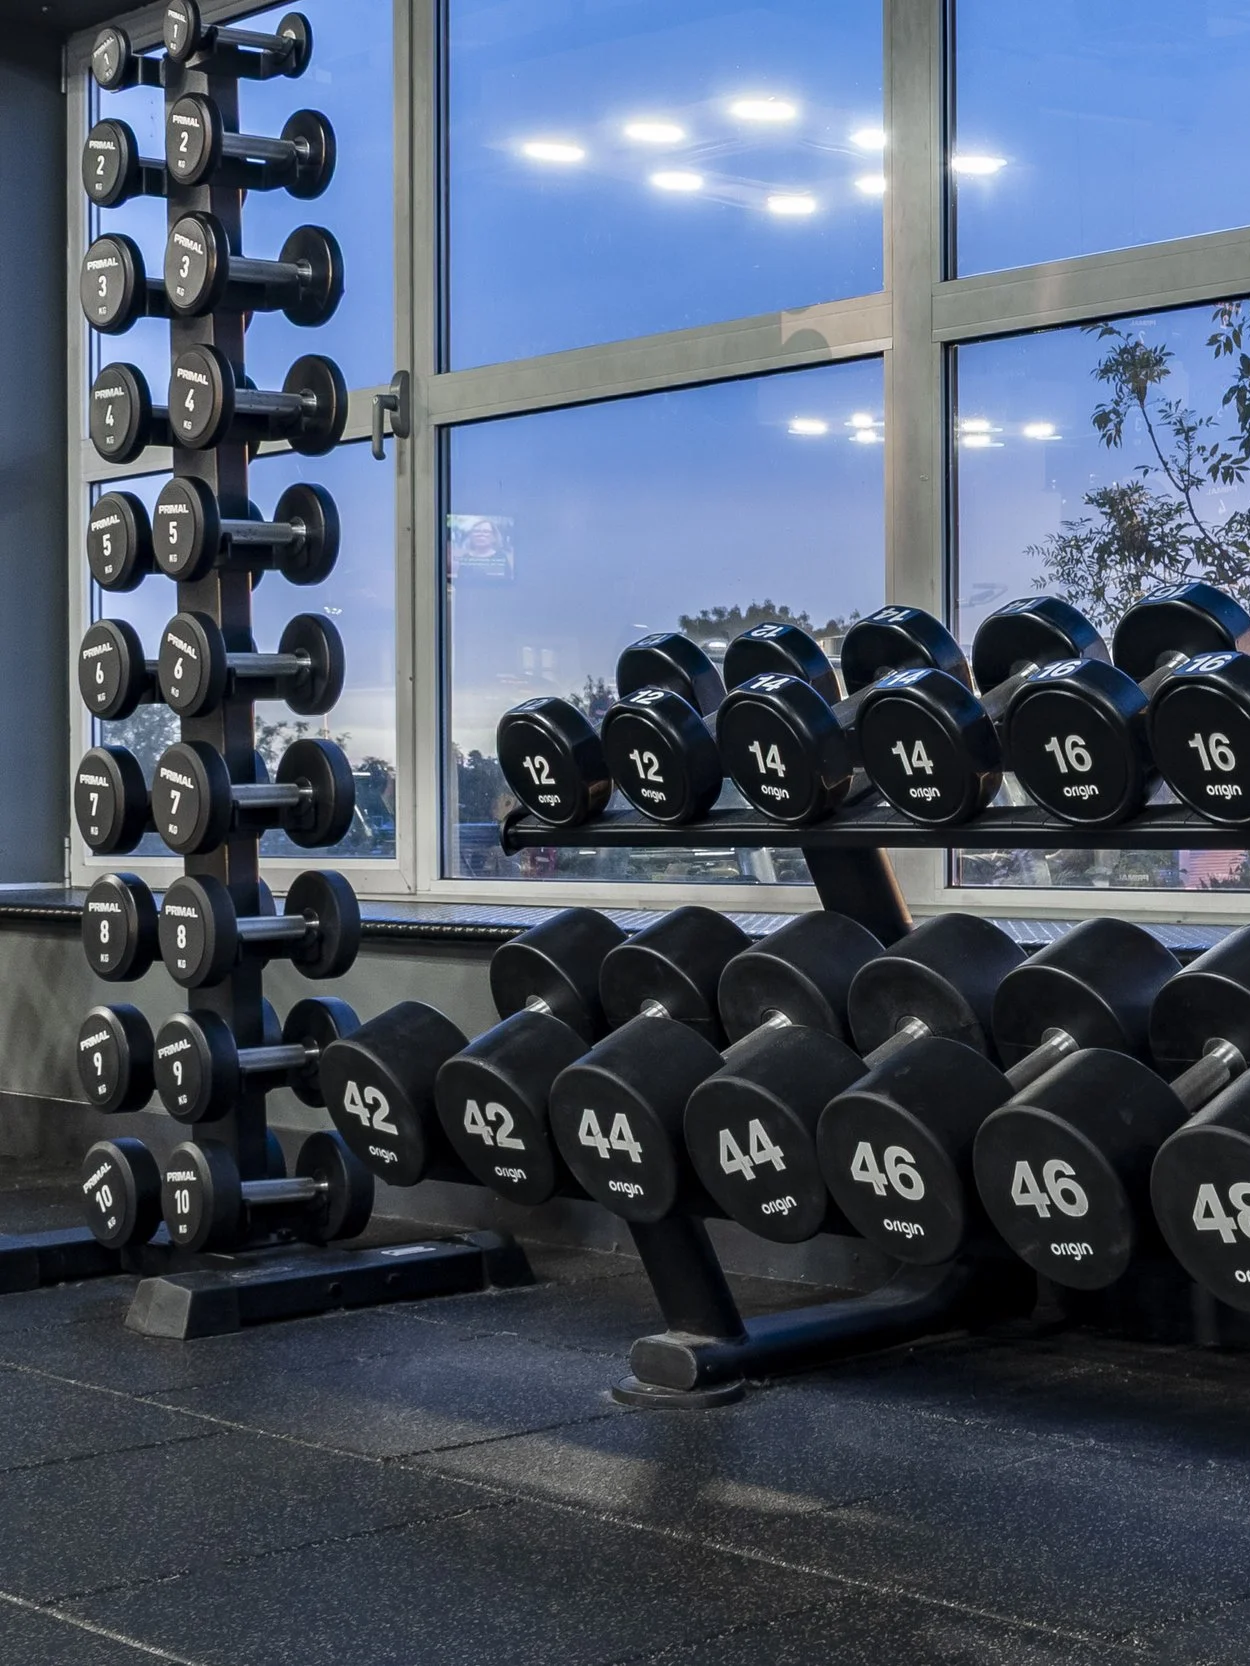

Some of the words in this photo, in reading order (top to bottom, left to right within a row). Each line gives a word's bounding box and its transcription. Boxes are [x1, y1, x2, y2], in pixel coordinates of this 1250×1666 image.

[174, 25, 177, 38] 1
[173, 115, 199, 127] PRIMAL
[89, 141, 115, 149] PRIMAL
[180, 132, 188, 152] 2
[97, 156, 104, 175] 2
[178, 160, 185, 168] KG
[174, 234, 203, 254] PRIMAL
[87, 258, 118, 270] PRIMAL
[180, 256, 189, 277] 3
[99, 276, 106, 296] 3
[177, 287, 184, 296] KG
[177, 368, 208, 385] PRIMAL
[95, 387, 124, 399] PRIMAL
[185, 389, 194, 411] 4
[106, 405, 114, 426] 4
[184, 421, 191, 429] KG
[107, 436, 114, 444] KG
[159, 504, 188, 513] PRIMAL
[91, 515, 120, 531] PRIMAL
[170, 522, 177, 544] 5
[103, 534, 111, 556] 5
[169, 554, 177, 562] KG
[105, 565, 112, 574] KG
[83, 643, 112, 659] PRIMAL
[168, 633, 197, 661] PRIMAL
[174, 658, 183, 679] 6
[1038, 662, 1080, 680] 16
[1189, 654, 1233, 672] 16
[96, 662, 104, 683] 6
[889, 670, 929, 686] 14
[752, 675, 790, 690] 14
[98, 693, 105, 701] KG
[171, 687, 179, 697] KG
[629, 689, 665, 705] 12
[749, 741, 785, 777] 14
[892, 741, 933, 775] 14
[1045, 735, 1092, 773] 16
[1189, 733, 1235, 771] 16
[523, 756, 555, 784] 12
[630, 750, 663, 782] 12
[80, 774, 108, 786] PRIMAL
[160, 768, 193, 788] PRIMAL
[538, 795, 560, 806] origin
[641, 789, 666, 802] origin
[761, 785, 789, 800] origin
[910, 787, 940, 801] origin
[1064, 785, 1098, 799] origin
[1207, 785, 1242, 799] origin
[90, 793, 98, 816] 7
[171, 790, 180, 814] 7
[91, 827, 98, 835] KG
[169, 824, 177, 834] KG
[89, 903, 121, 912] PRIMAL
[166, 905, 198, 917] PRIMAL
[101, 920, 109, 943] 8
[177, 925, 186, 948] 8
[101, 954, 109, 962] KG
[178, 960, 186, 968] KG
[80, 1031, 109, 1051] PRIMAL
[158, 1039, 191, 1058] PRIMAL
[94, 1052, 102, 1075] 9
[173, 1061, 182, 1085] 9
[98, 1084, 106, 1094] KG
[178, 1095, 187, 1104] KG
[344, 1081, 398, 1135] 42
[464, 1100, 525, 1150] 42
[579, 1109, 642, 1163] 44
[369, 1146, 397, 1163] origin
[720, 1119, 786, 1180] 44
[83, 1163, 111, 1195] PRIMAL
[167, 1171, 196, 1181] PRIMAL
[495, 1167, 526, 1182] origin
[851, 1142, 924, 1200] 46
[609, 1181, 643, 1198] origin
[1011, 1159, 1088, 1217] 46
[96, 1187, 112, 1212] 10
[175, 1190, 189, 1213] 10
[762, 1196, 797, 1215] origin
[108, 1217, 116, 1229] KG
[179, 1225, 187, 1233] KG
[884, 1219, 924, 1238] origin
[1051, 1243, 1093, 1260] origin
